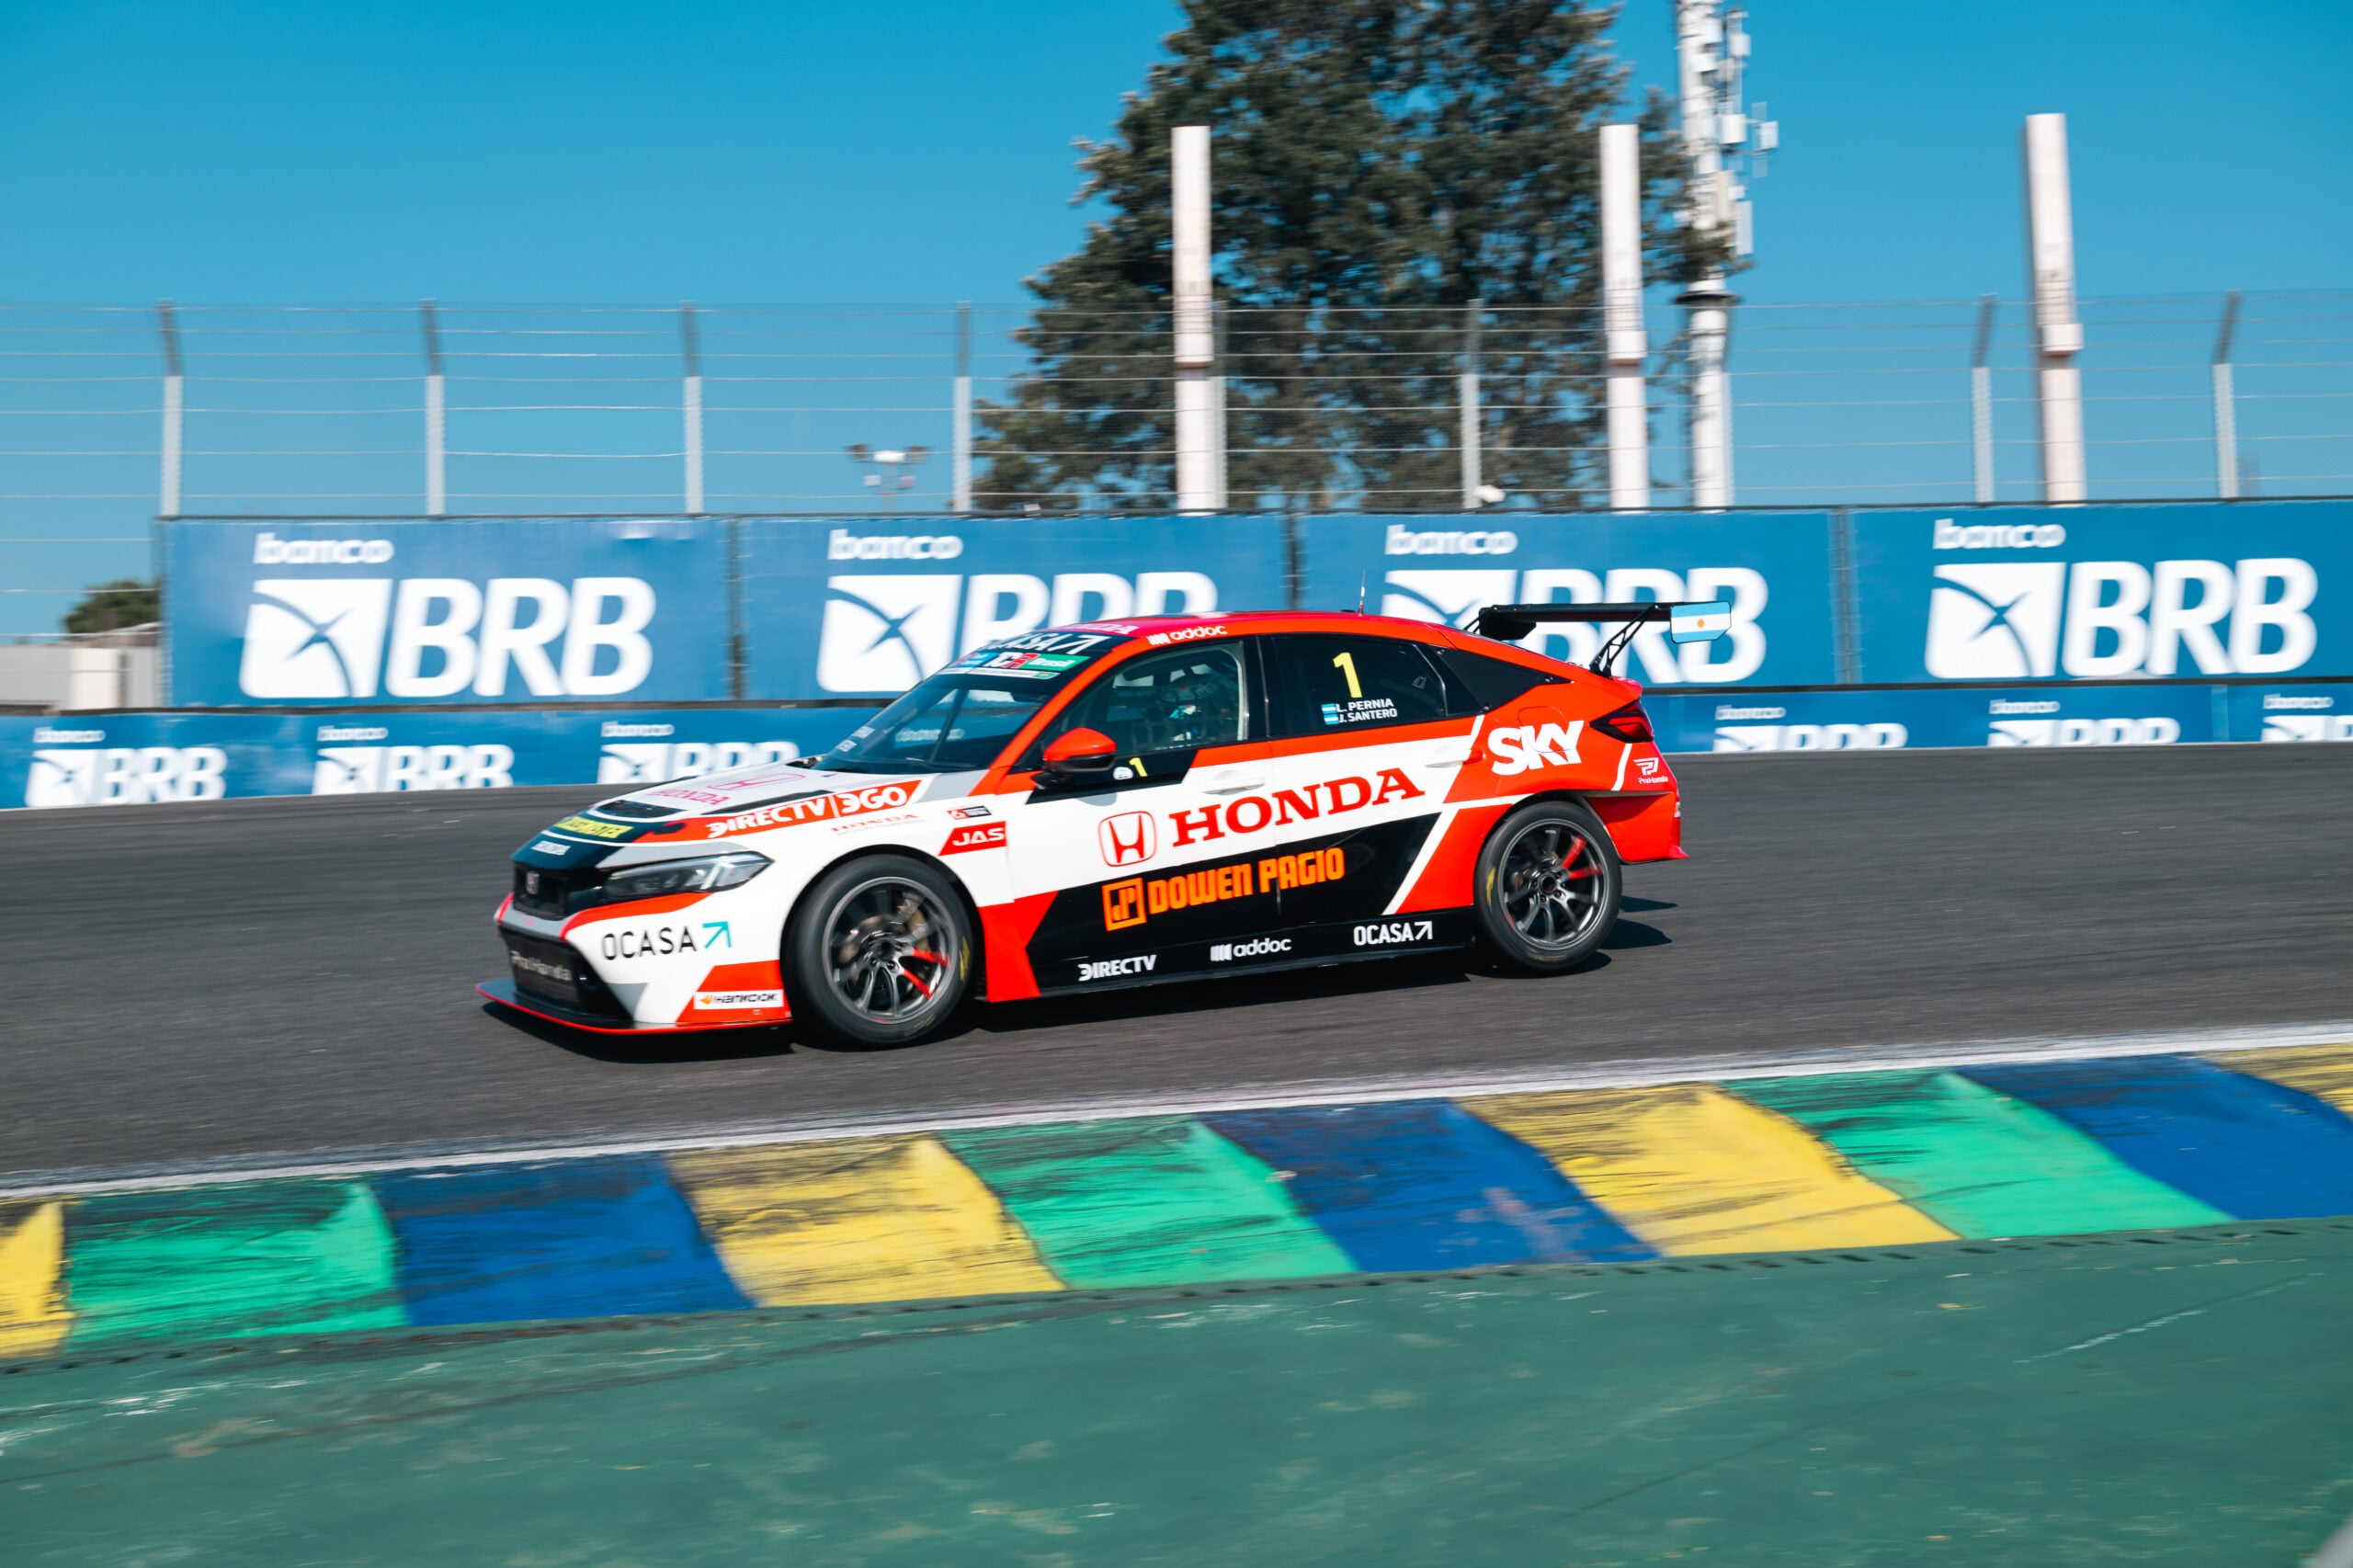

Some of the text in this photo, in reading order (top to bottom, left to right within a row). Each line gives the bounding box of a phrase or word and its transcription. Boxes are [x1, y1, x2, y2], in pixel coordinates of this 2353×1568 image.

[254, 533, 394, 564] banco
[827, 528, 964, 560] banco
[1385, 524, 1518, 555] banco
[1933, 518, 2066, 550] banco
[1170, 625, 1228, 641] addoc
[2063, 558, 2318, 677] BRB
[386, 576, 656, 696] BRB
[1333, 652, 1362, 699] 1
[1347, 699, 1394, 711] PERNIA
[1347, 708, 1398, 722] SANTERO
[1486, 720, 1584, 776] SKY
[100, 747, 228, 805] BRB
[1129, 757, 1148, 778] 1
[1169, 767, 1425, 846] HONDA
[952, 827, 1005, 846] JAS
[602, 926, 698, 960] OCASA
[1233, 937, 1292, 958] addoc
[1354, 923, 1414, 947] OCASA
